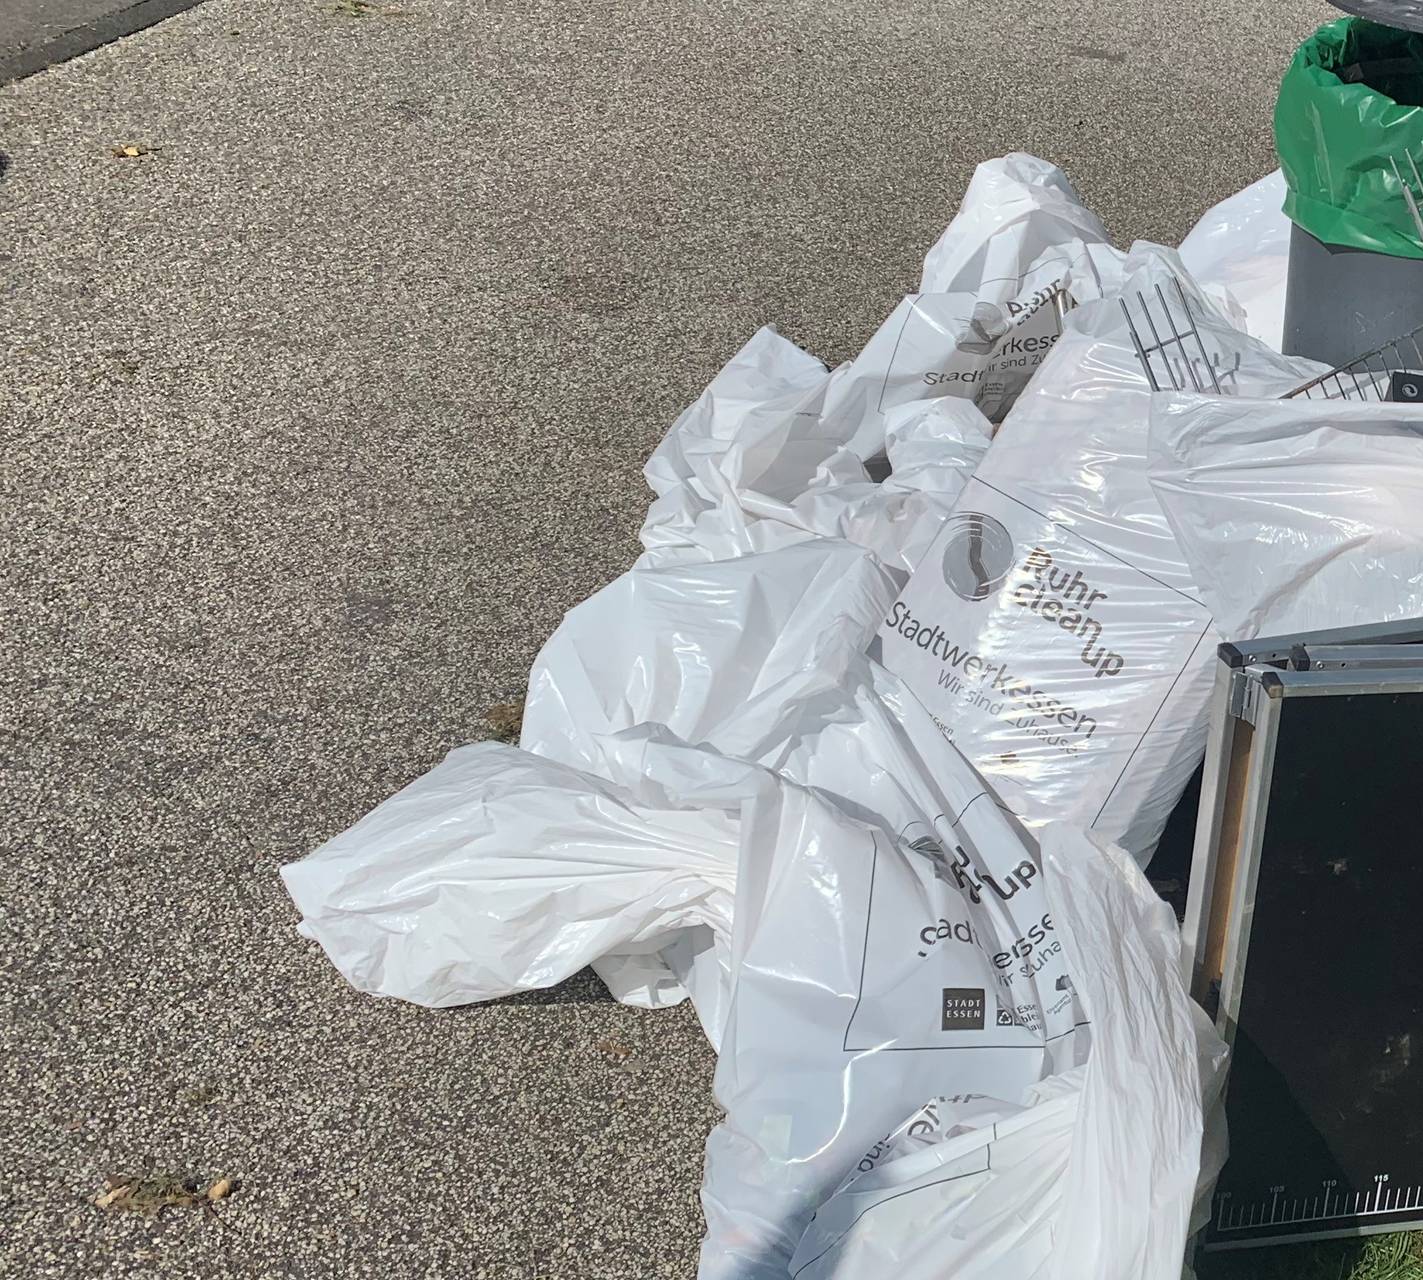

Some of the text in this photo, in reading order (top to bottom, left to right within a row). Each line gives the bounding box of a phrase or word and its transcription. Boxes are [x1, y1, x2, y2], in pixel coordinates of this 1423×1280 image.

[1001, 355, 1027, 369] sind
[1022, 547, 1108, 610] Ruhr
[937, 669, 965, 696] Wir
[965, 690, 1004, 716] sind
[946, 999, 981, 1008] STADT
[946, 1009, 981, 1018] ESSEN
[1374, 1174, 1389, 1182] 115
